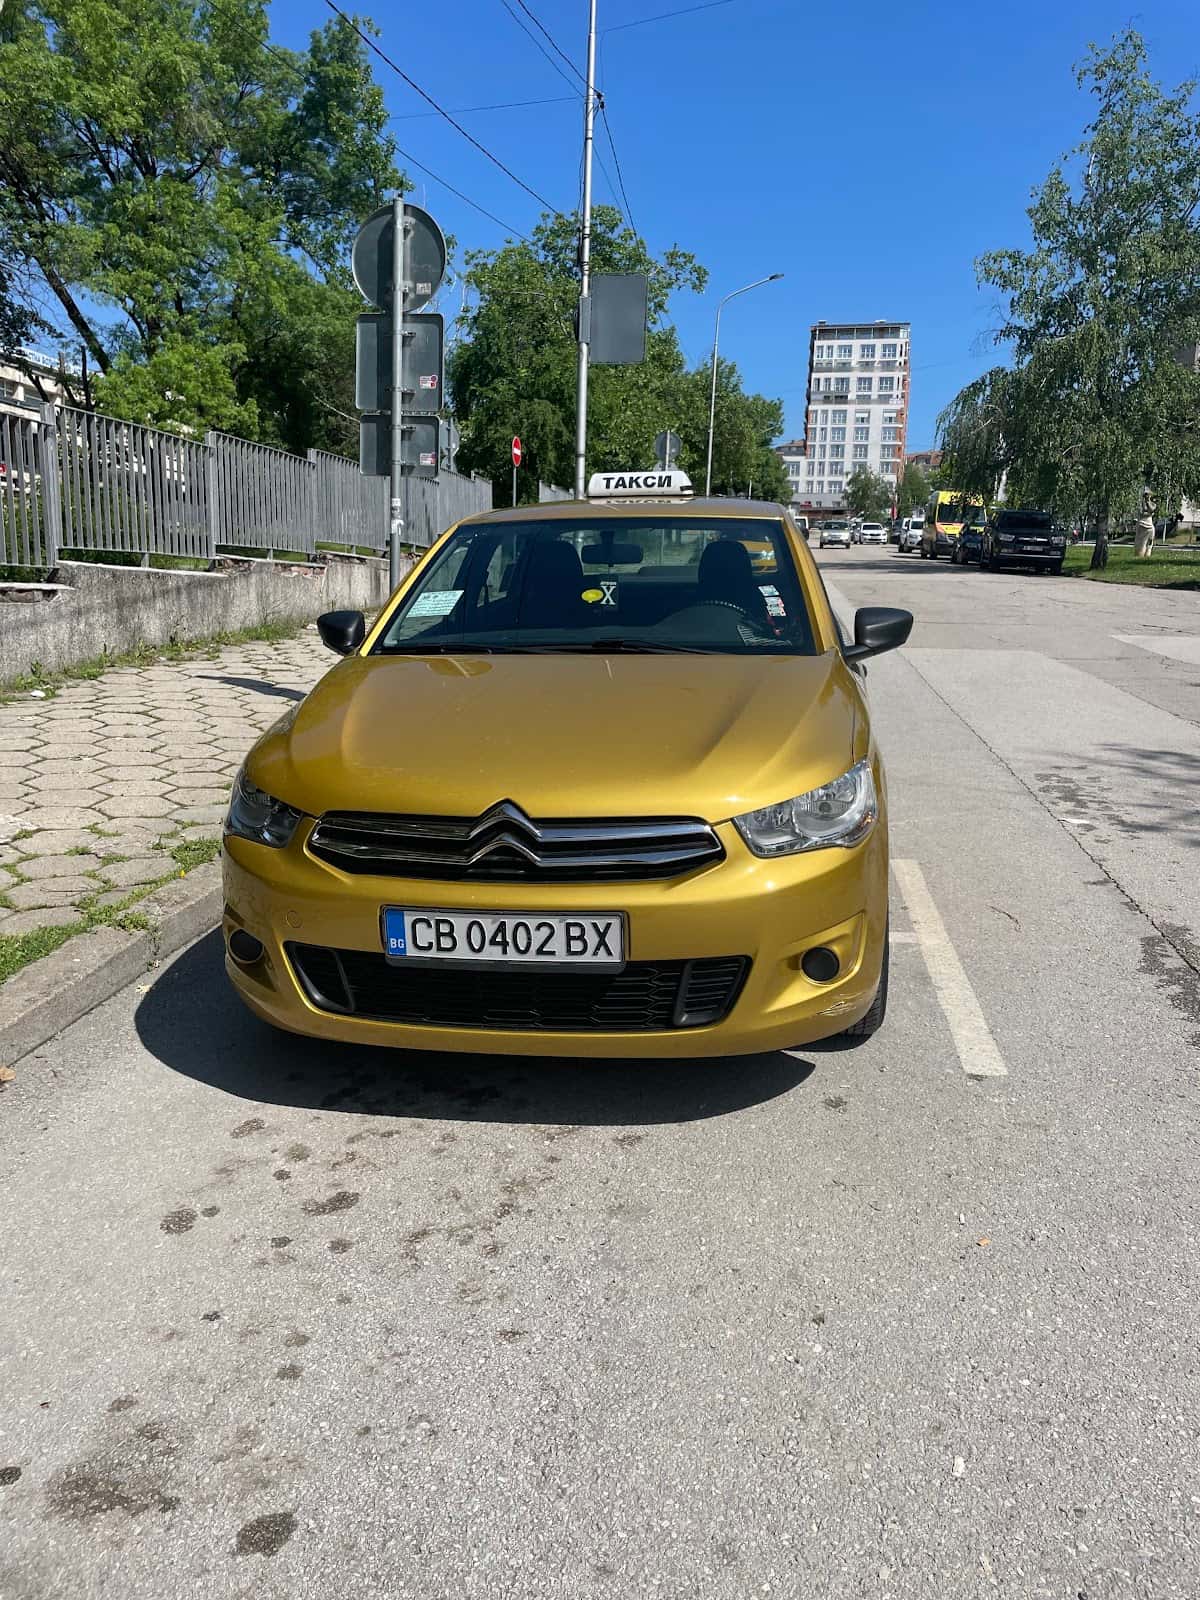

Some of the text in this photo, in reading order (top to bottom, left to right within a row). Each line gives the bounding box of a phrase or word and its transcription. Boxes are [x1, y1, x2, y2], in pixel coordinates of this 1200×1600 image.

[603, 475, 672, 489] ТАКСИ
[390, 938, 405, 949] BG
[411, 917, 613, 957] CB 0402 BX
